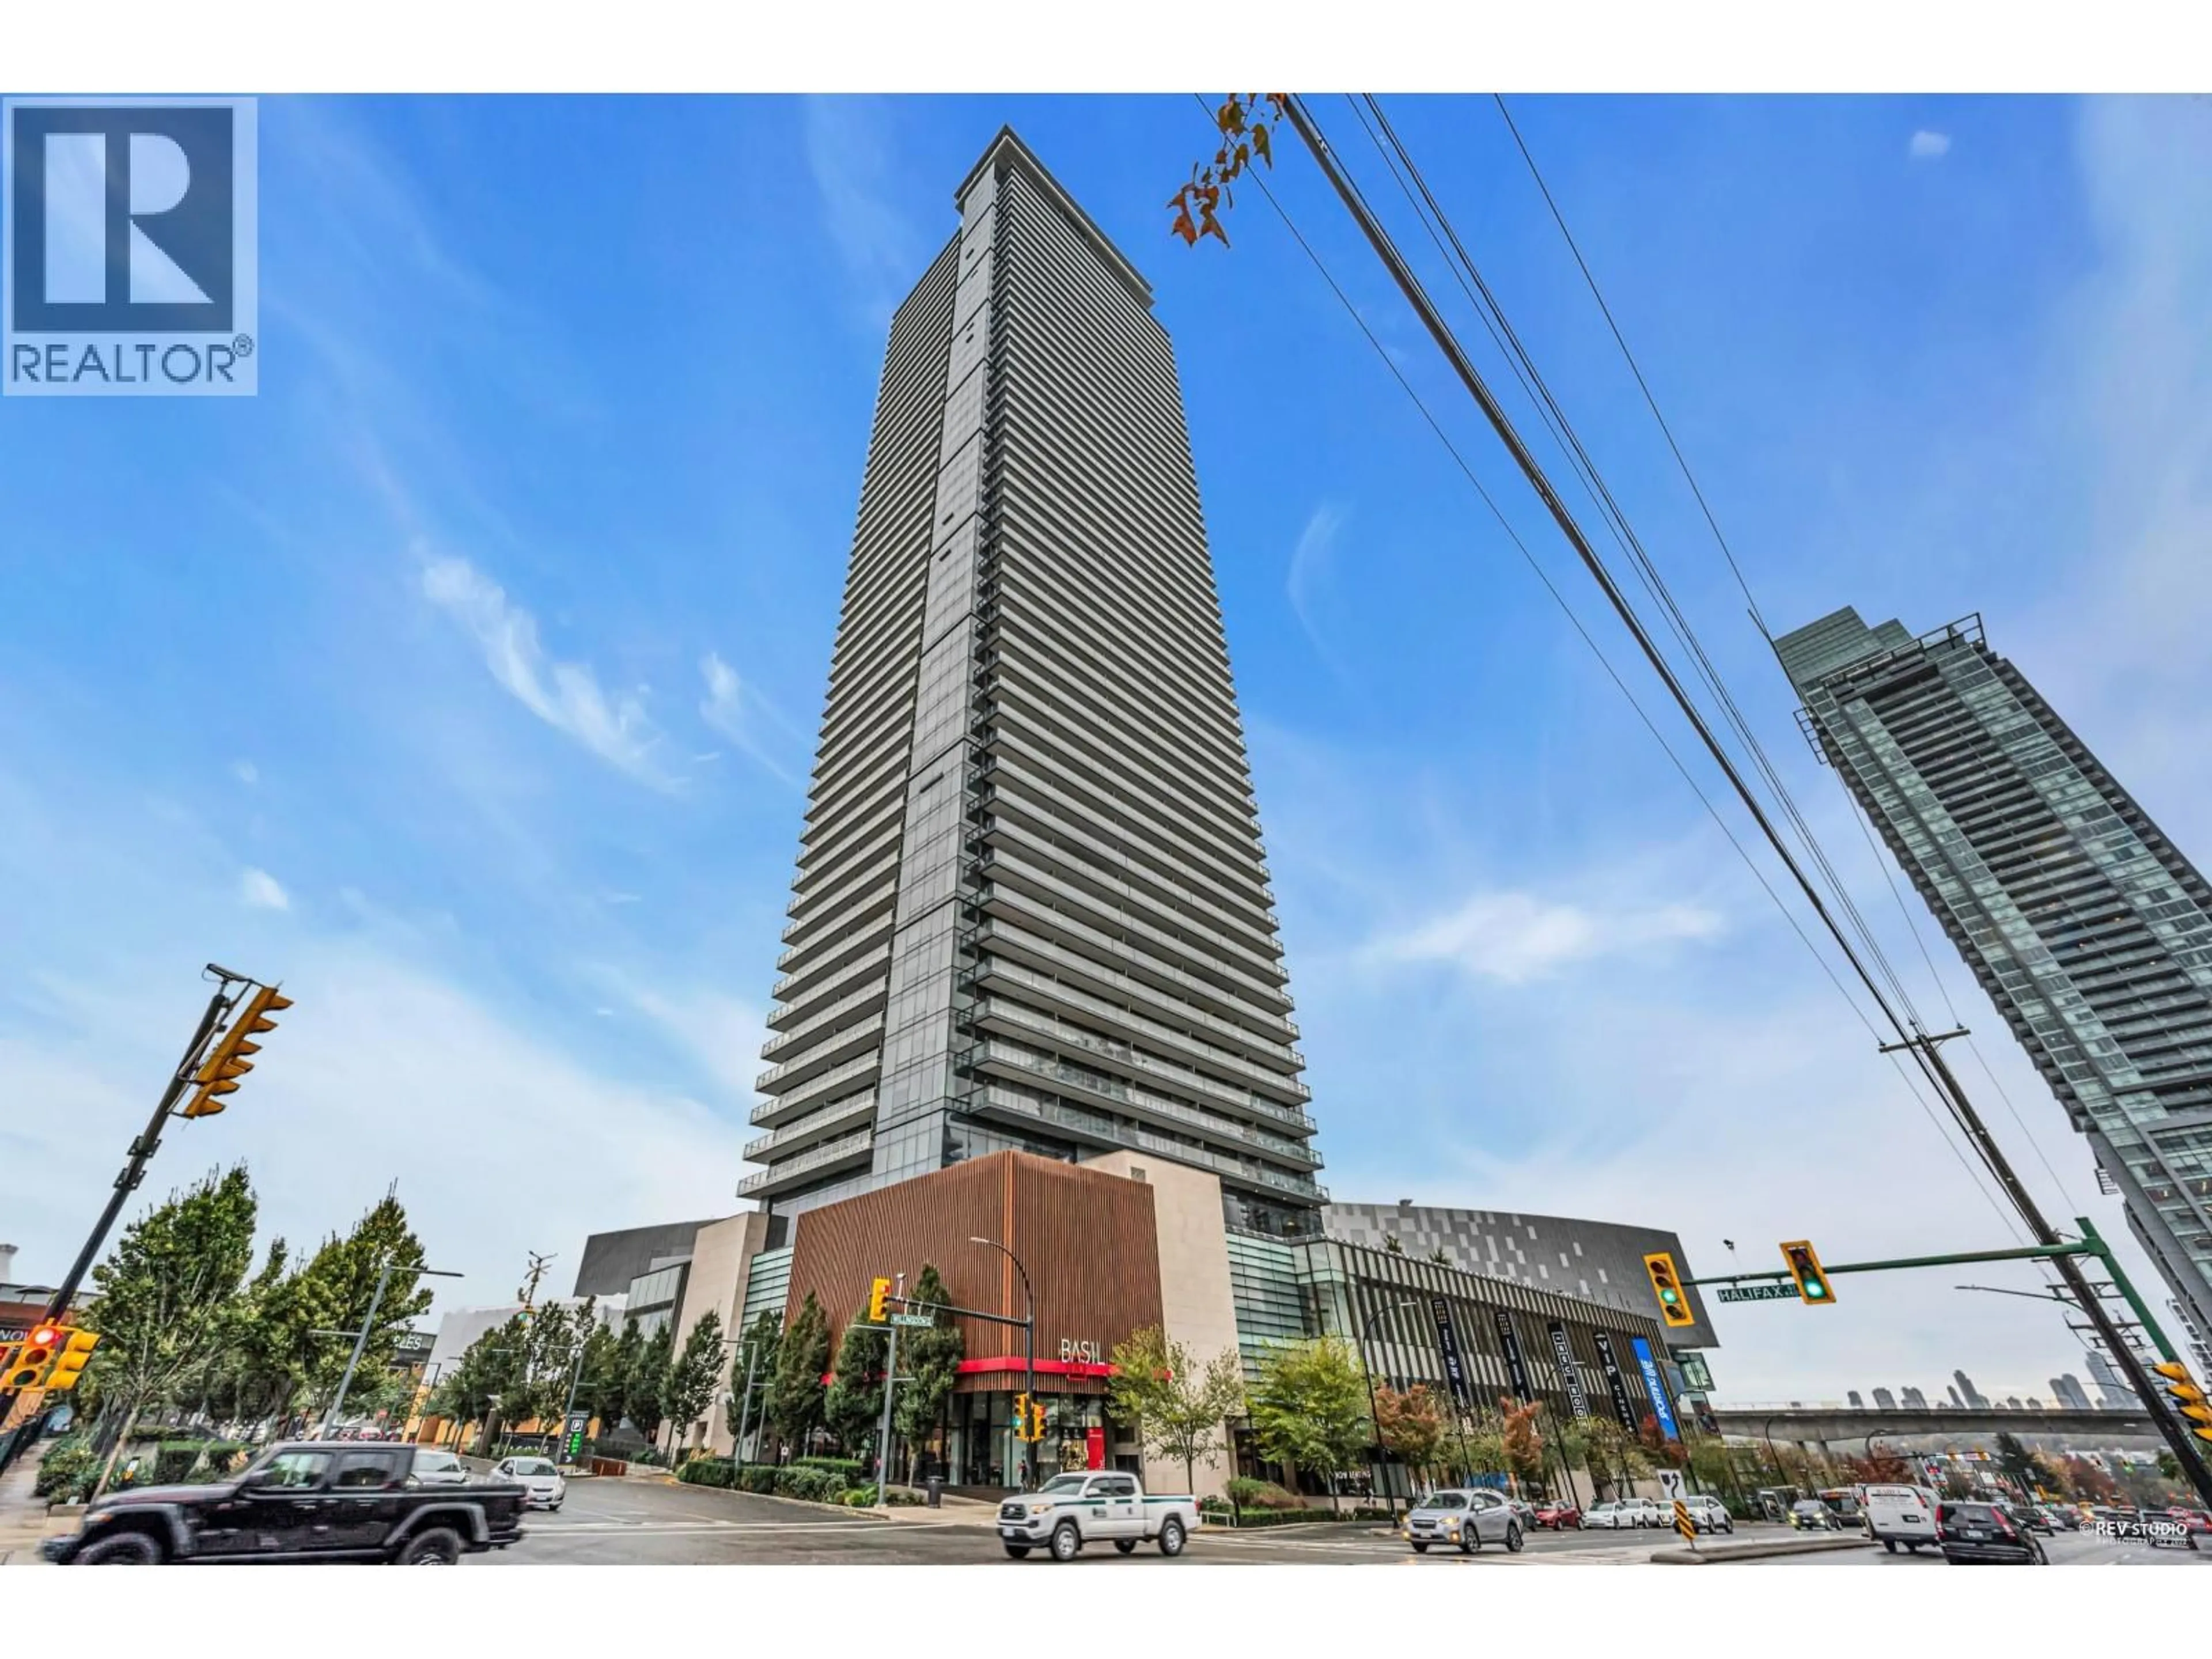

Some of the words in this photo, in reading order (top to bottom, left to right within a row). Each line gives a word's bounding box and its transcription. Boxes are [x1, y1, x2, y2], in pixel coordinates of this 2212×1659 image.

[1720, 1286, 1783, 1300] HALIFAX
[1061, 1338, 1105, 1365] BASIL
[1598, 1340, 1616, 1376] VIP
